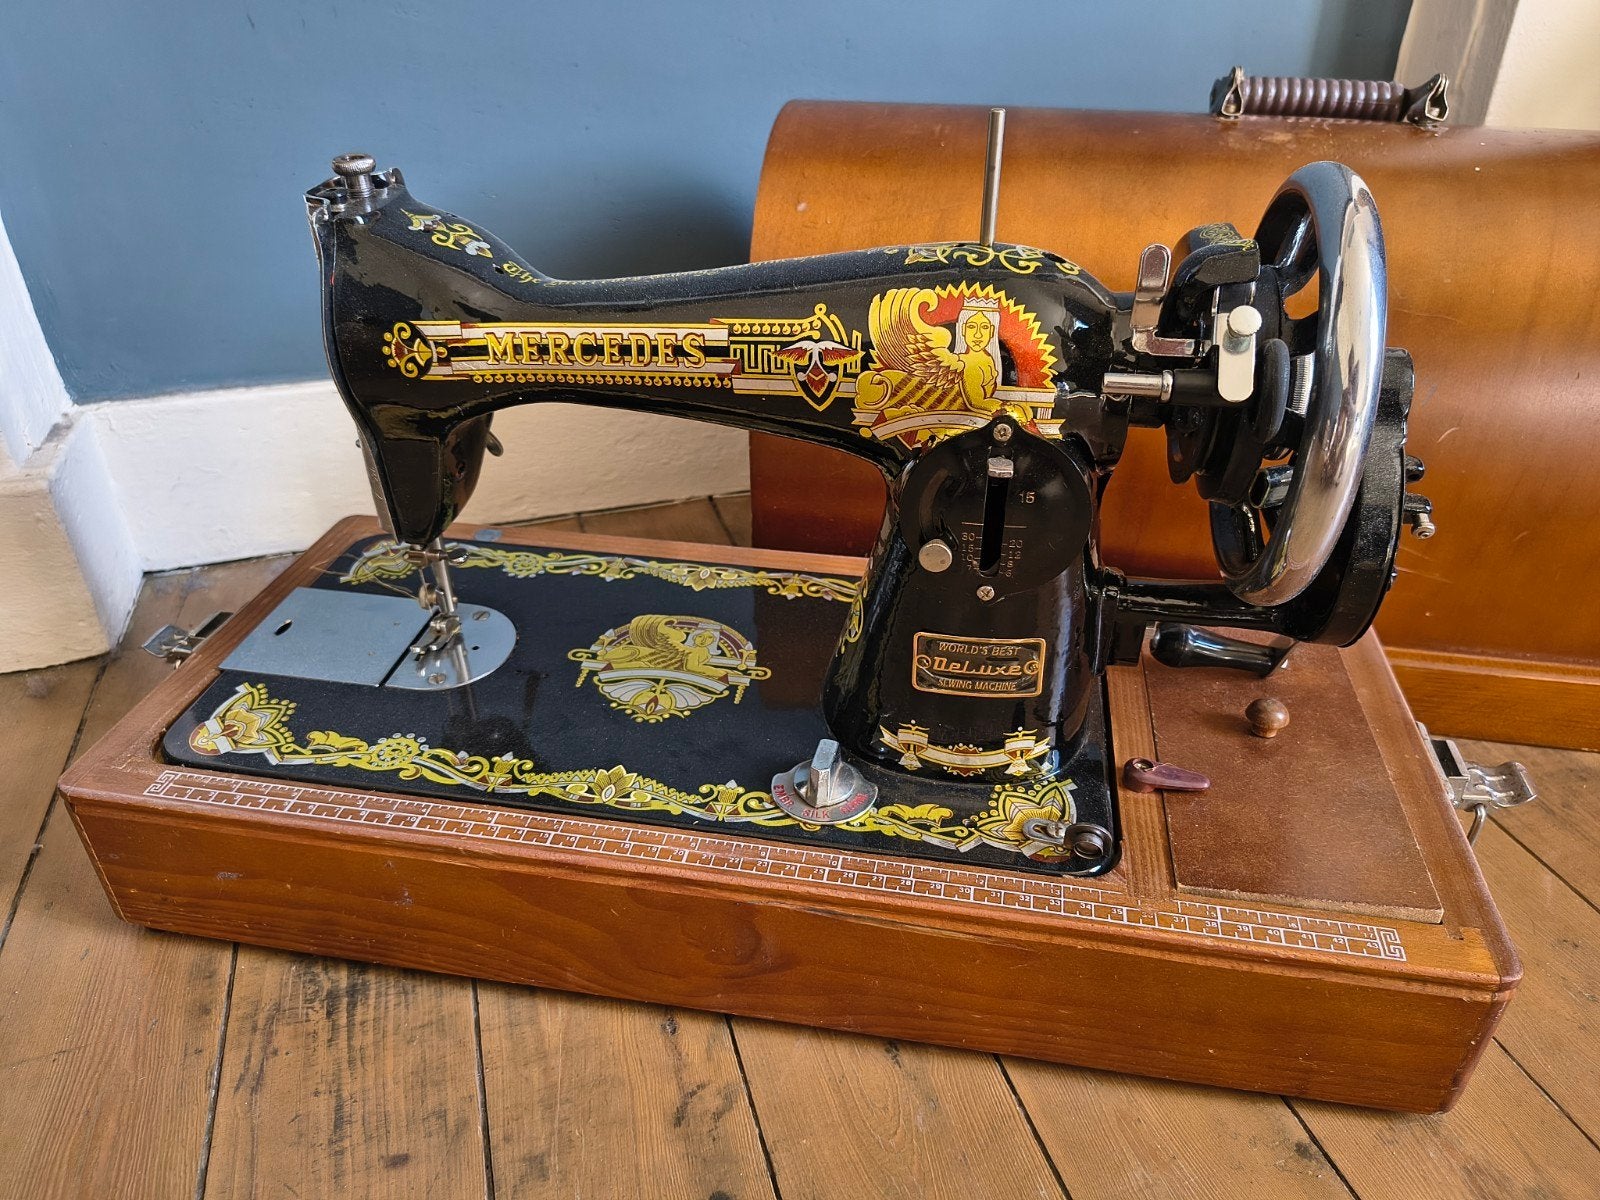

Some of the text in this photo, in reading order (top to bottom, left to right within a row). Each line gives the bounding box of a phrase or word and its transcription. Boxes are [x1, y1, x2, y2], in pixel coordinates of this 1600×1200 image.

[484, 331, 708, 369] MERCEDES
[1019, 491, 1036, 504] 15
[961, 532, 975, 541] 30
[1009, 540, 1024, 548] 20
[938, 641, 1021, 657] WORLD'S BEST
[937, 678, 1018, 691] SEWING MACHINE
[802, 808, 831, 819] SILK
